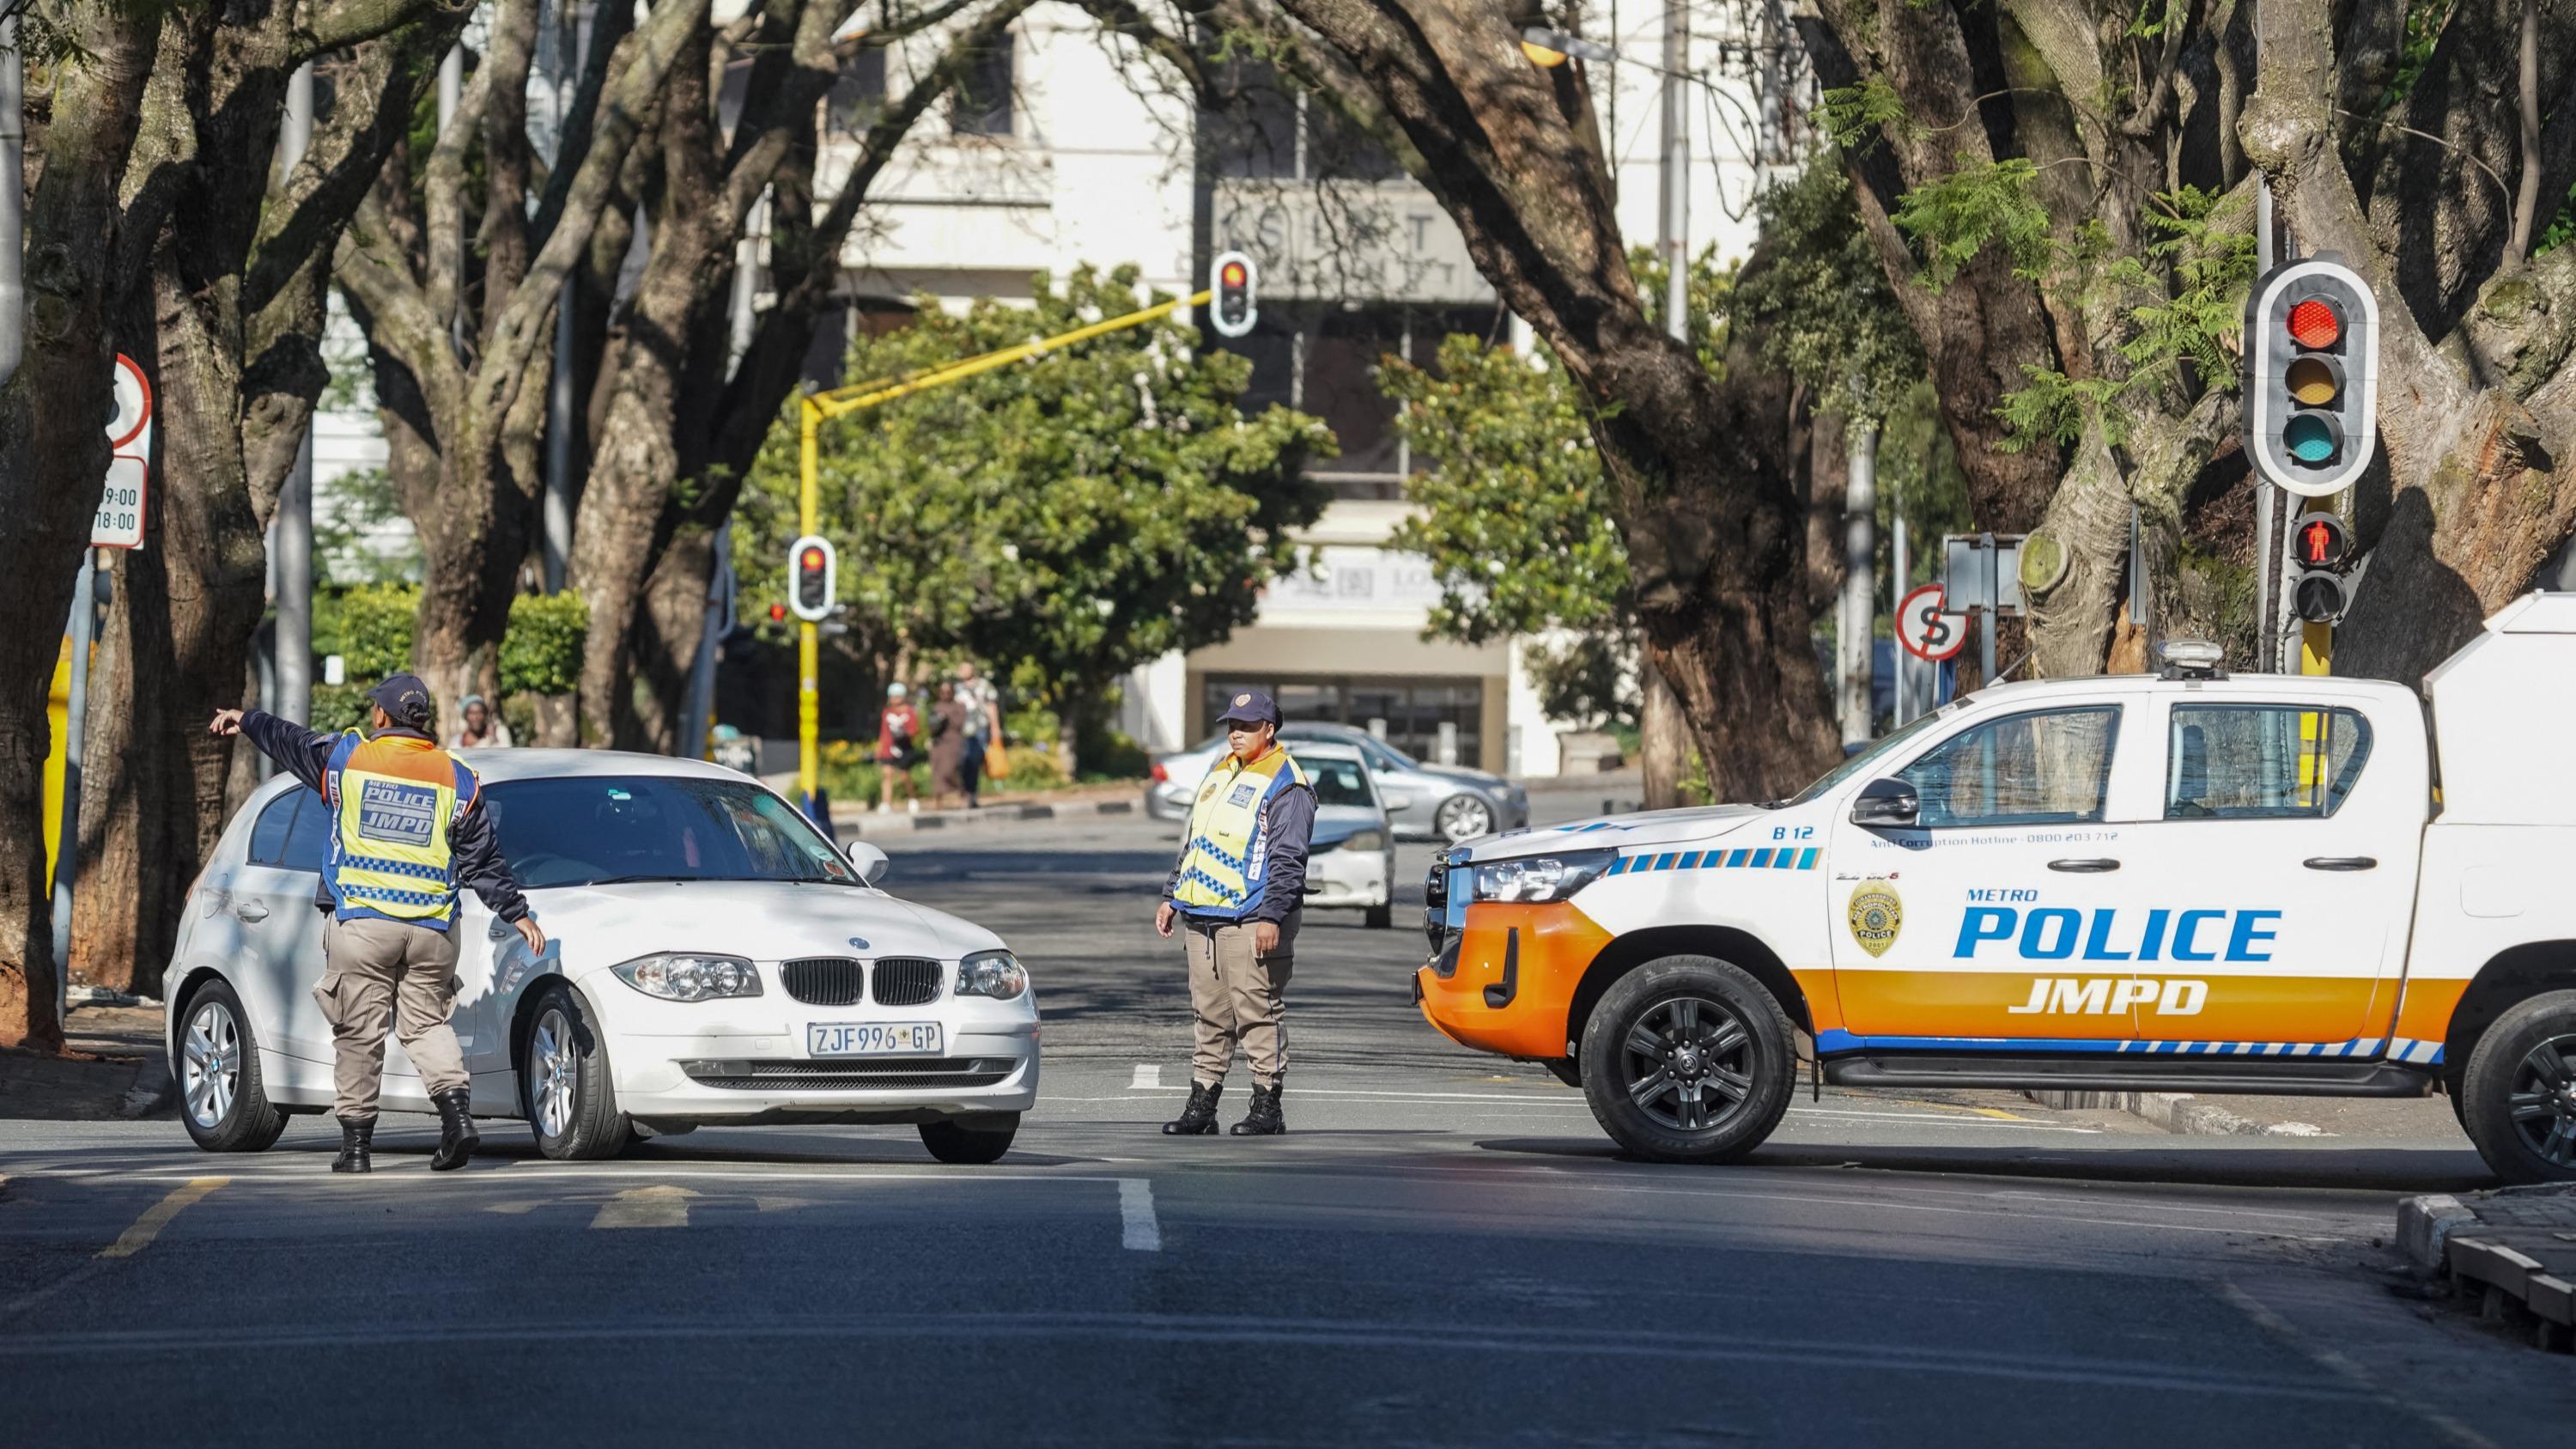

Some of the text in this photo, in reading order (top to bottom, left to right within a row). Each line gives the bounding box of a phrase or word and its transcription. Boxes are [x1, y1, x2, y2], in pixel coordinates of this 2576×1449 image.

[101, 487, 137, 506] 9:00
[96, 511, 135, 530] 18:00
[368, 780, 398, 790] METRO
[364, 787, 435, 808] POLICE
[361, 812, 434, 834] JMPD
[1772, 826, 1814, 840] B 12
[1871, 831, 2118, 848] Anti Corruption Hotline 0800 203 712
[1965, 888, 2038, 902] METRO
[1860, 930, 1893, 939] POLICE
[1953, 906, 2282, 962] POLICE
[2008, 978, 2208, 1016] JMPD
[816, 1026, 935, 1052] ZJF996 GP
